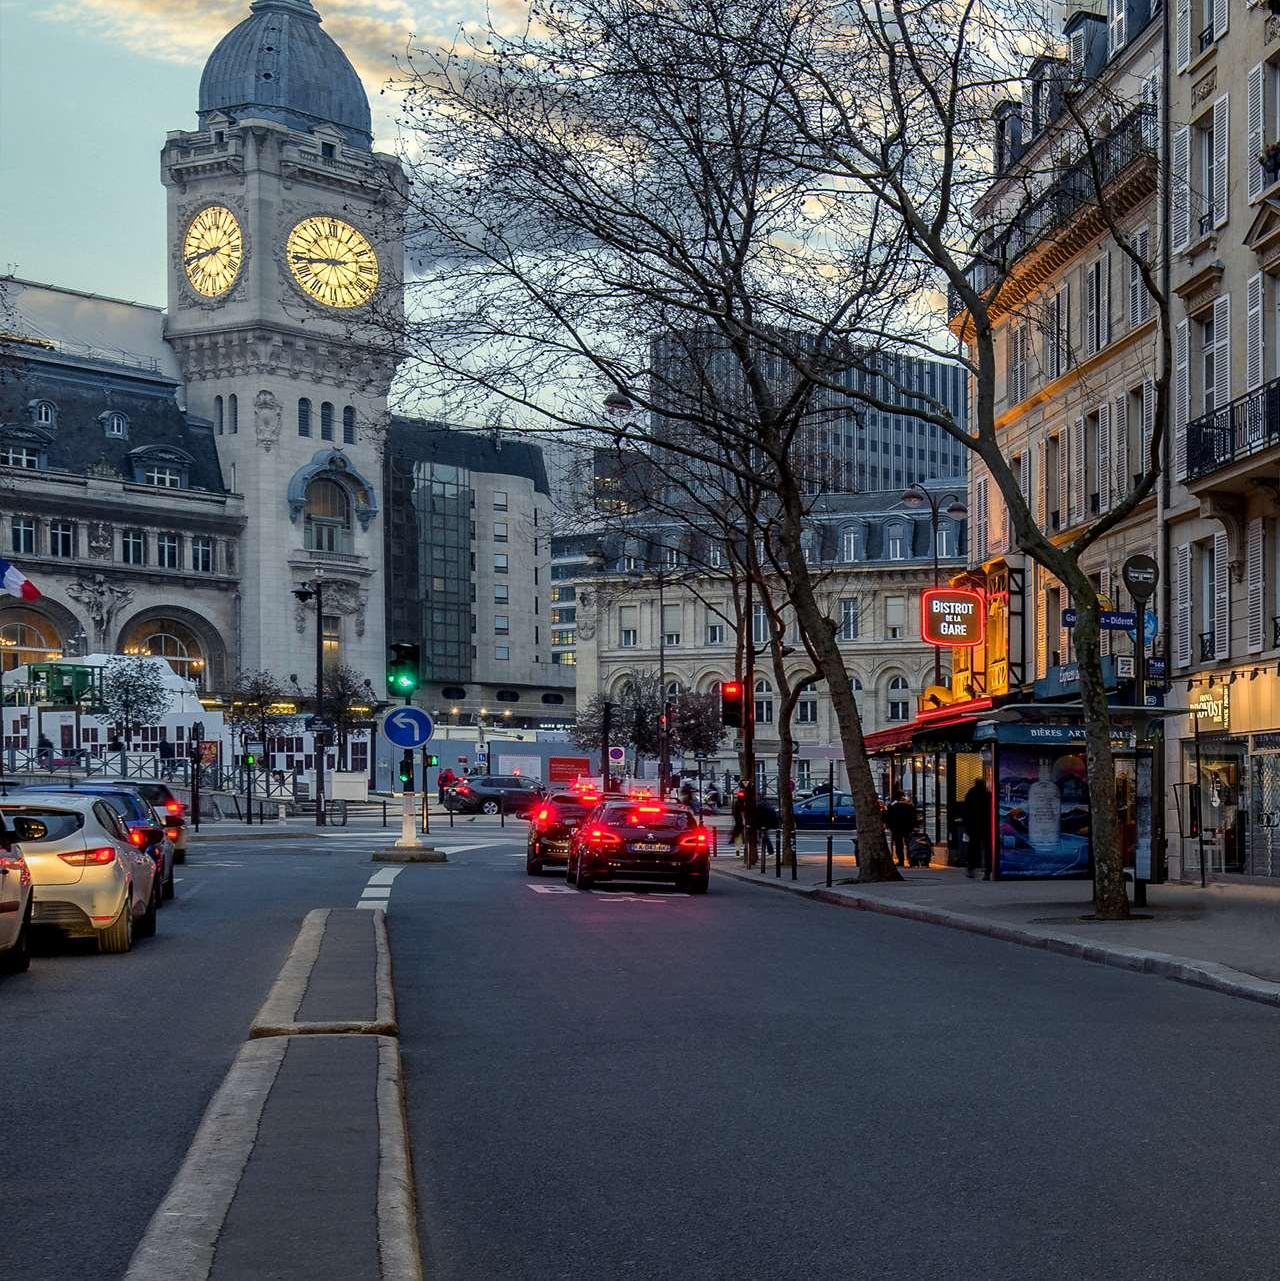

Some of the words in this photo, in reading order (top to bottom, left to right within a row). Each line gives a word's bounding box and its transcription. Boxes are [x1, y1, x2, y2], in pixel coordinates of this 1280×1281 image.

[932, 600, 974, 615] BISTROT
[1110, 616, 1134, 625] Diderot
[941, 622, 967, 636] GARE
[1030, 727, 1062, 737] BIÈRES
